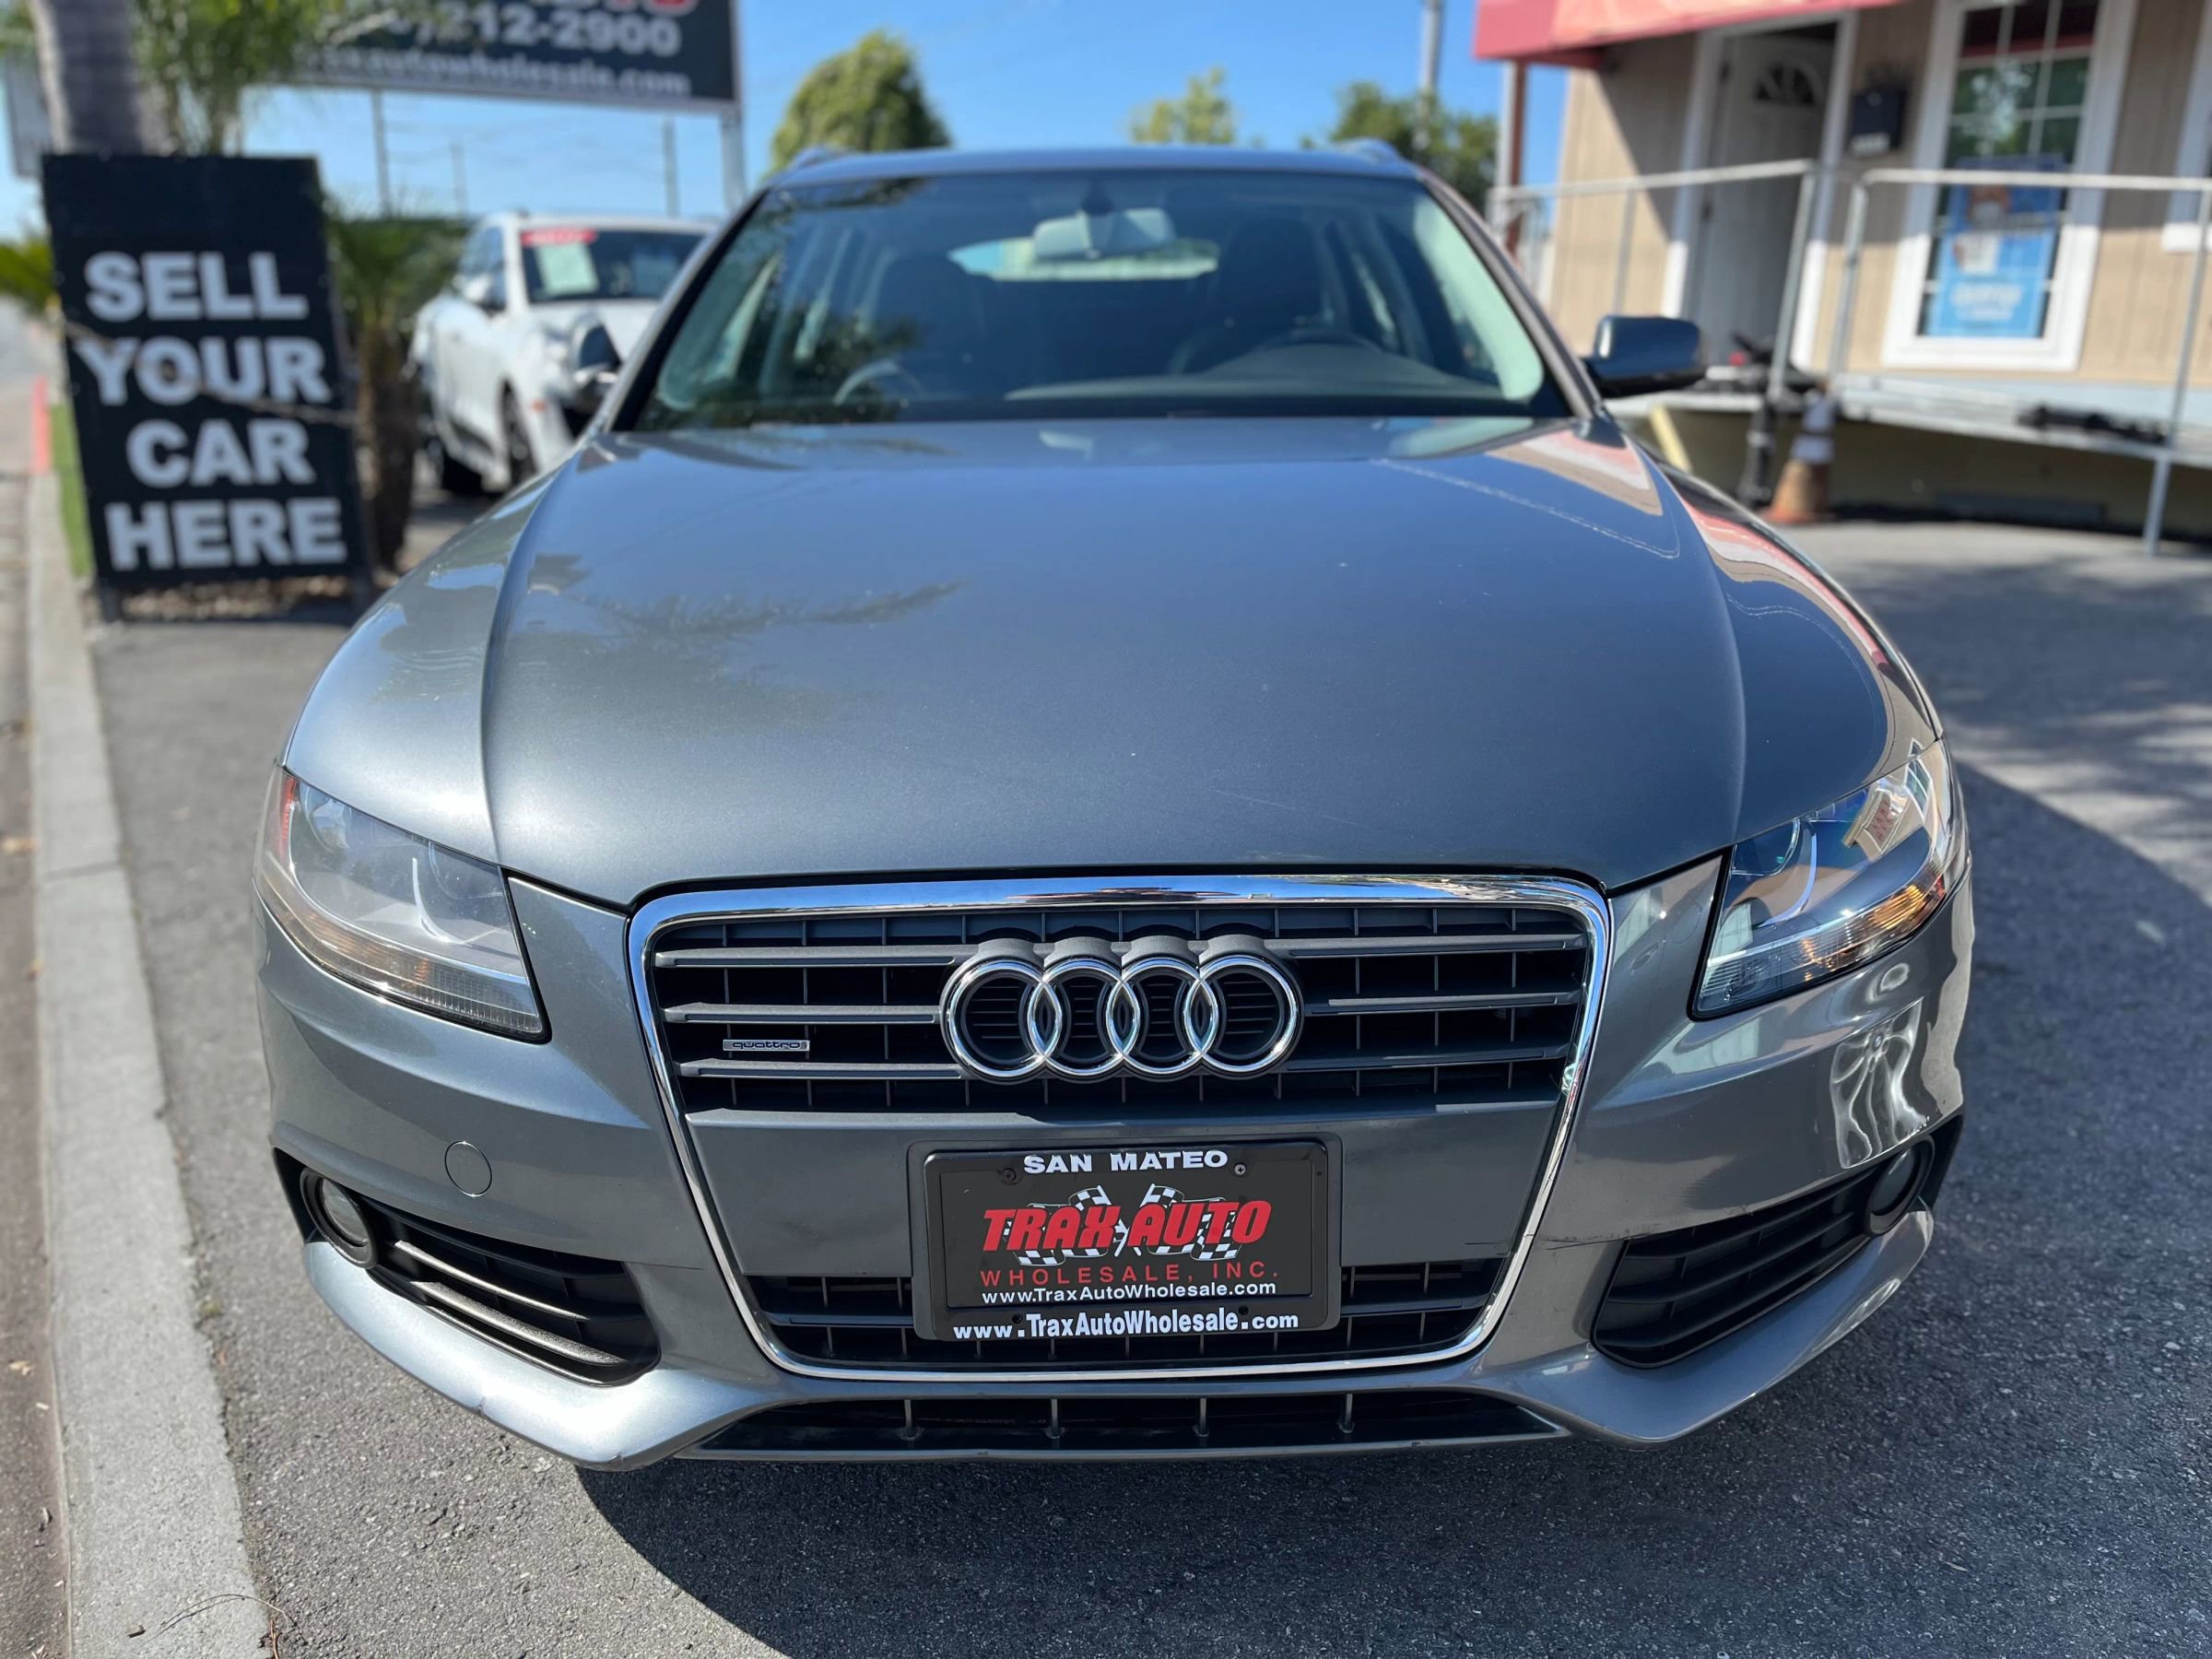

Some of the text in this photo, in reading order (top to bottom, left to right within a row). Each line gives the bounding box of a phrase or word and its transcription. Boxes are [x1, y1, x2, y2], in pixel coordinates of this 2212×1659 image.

[85, 252, 309, 320] SELL
[75, 336, 331, 406] YOUR
[126, 419, 315, 488] CAR
[104, 498, 347, 570] HERE
[733, 1041, 801, 1050] quattro
[1024, 1150, 1229, 1174] SAN MATEO
[982, 1200, 1273, 1252] TRAX AUTO
[980, 1260, 1279, 1288] WHOLESALE, INC.
[982, 1281, 1277, 1304] www.TraxAutoWholesale.com
[953, 1307, 1299, 1339] www.TraxAutoWholesale.com
